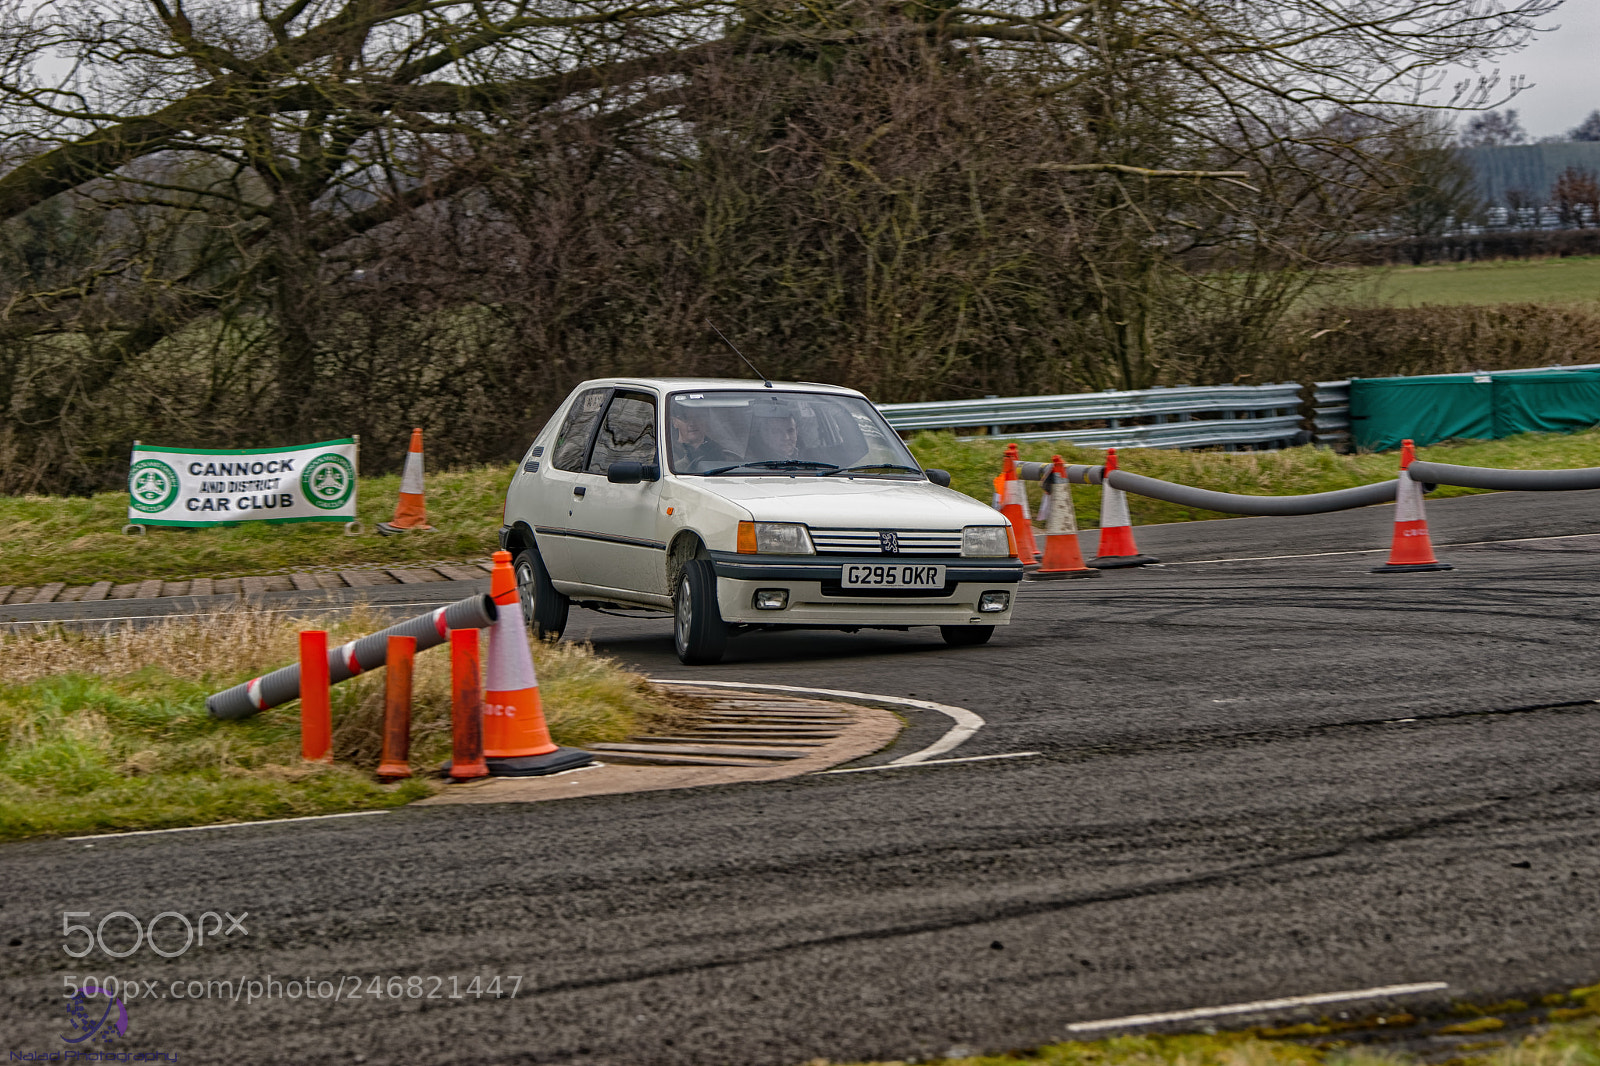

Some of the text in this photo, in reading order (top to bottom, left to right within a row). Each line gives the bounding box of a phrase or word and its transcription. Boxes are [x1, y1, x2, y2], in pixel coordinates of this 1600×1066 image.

[189, 459, 295, 476] CANNOCK
[199, 478, 281, 493] AND DISTRICT
[187, 493, 294, 511] CAR CLUB
[848, 566, 938, 585] G295 OKR
